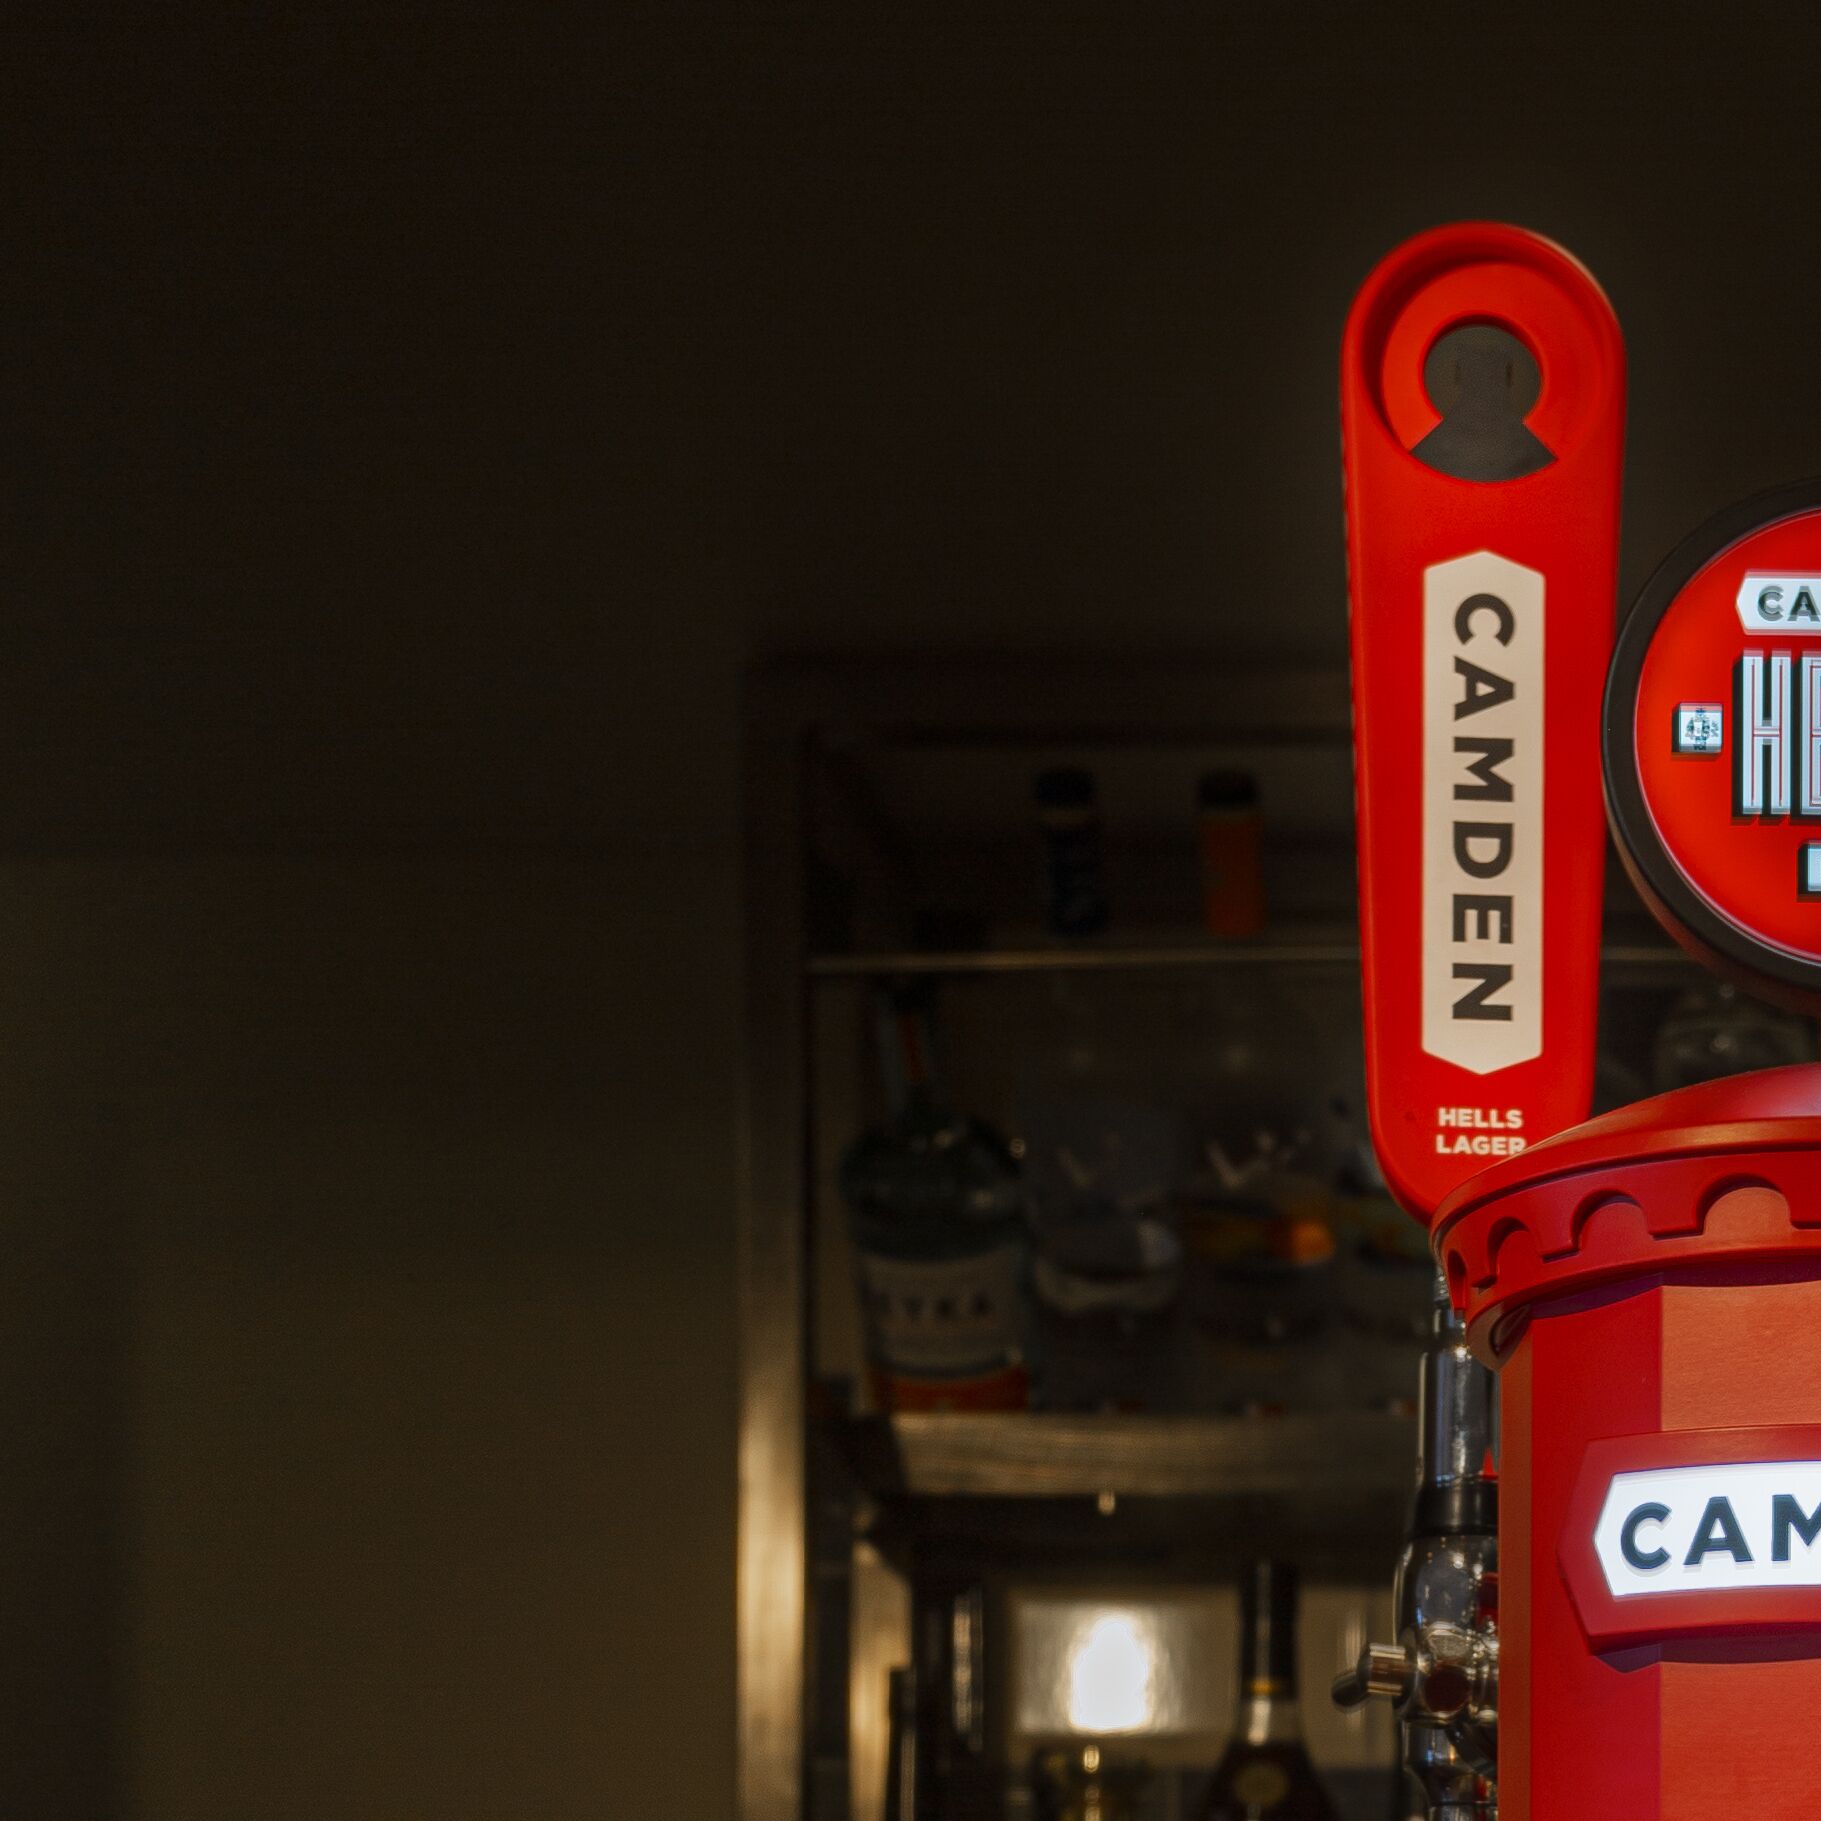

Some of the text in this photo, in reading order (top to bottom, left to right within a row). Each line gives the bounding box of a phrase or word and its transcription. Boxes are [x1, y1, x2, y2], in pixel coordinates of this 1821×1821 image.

[1452, 592, 1516, 1022] CAMDEN
[1437, 1107, 1524, 1129] HELLS
[1435, 1134, 1527, 1156] LAGER
